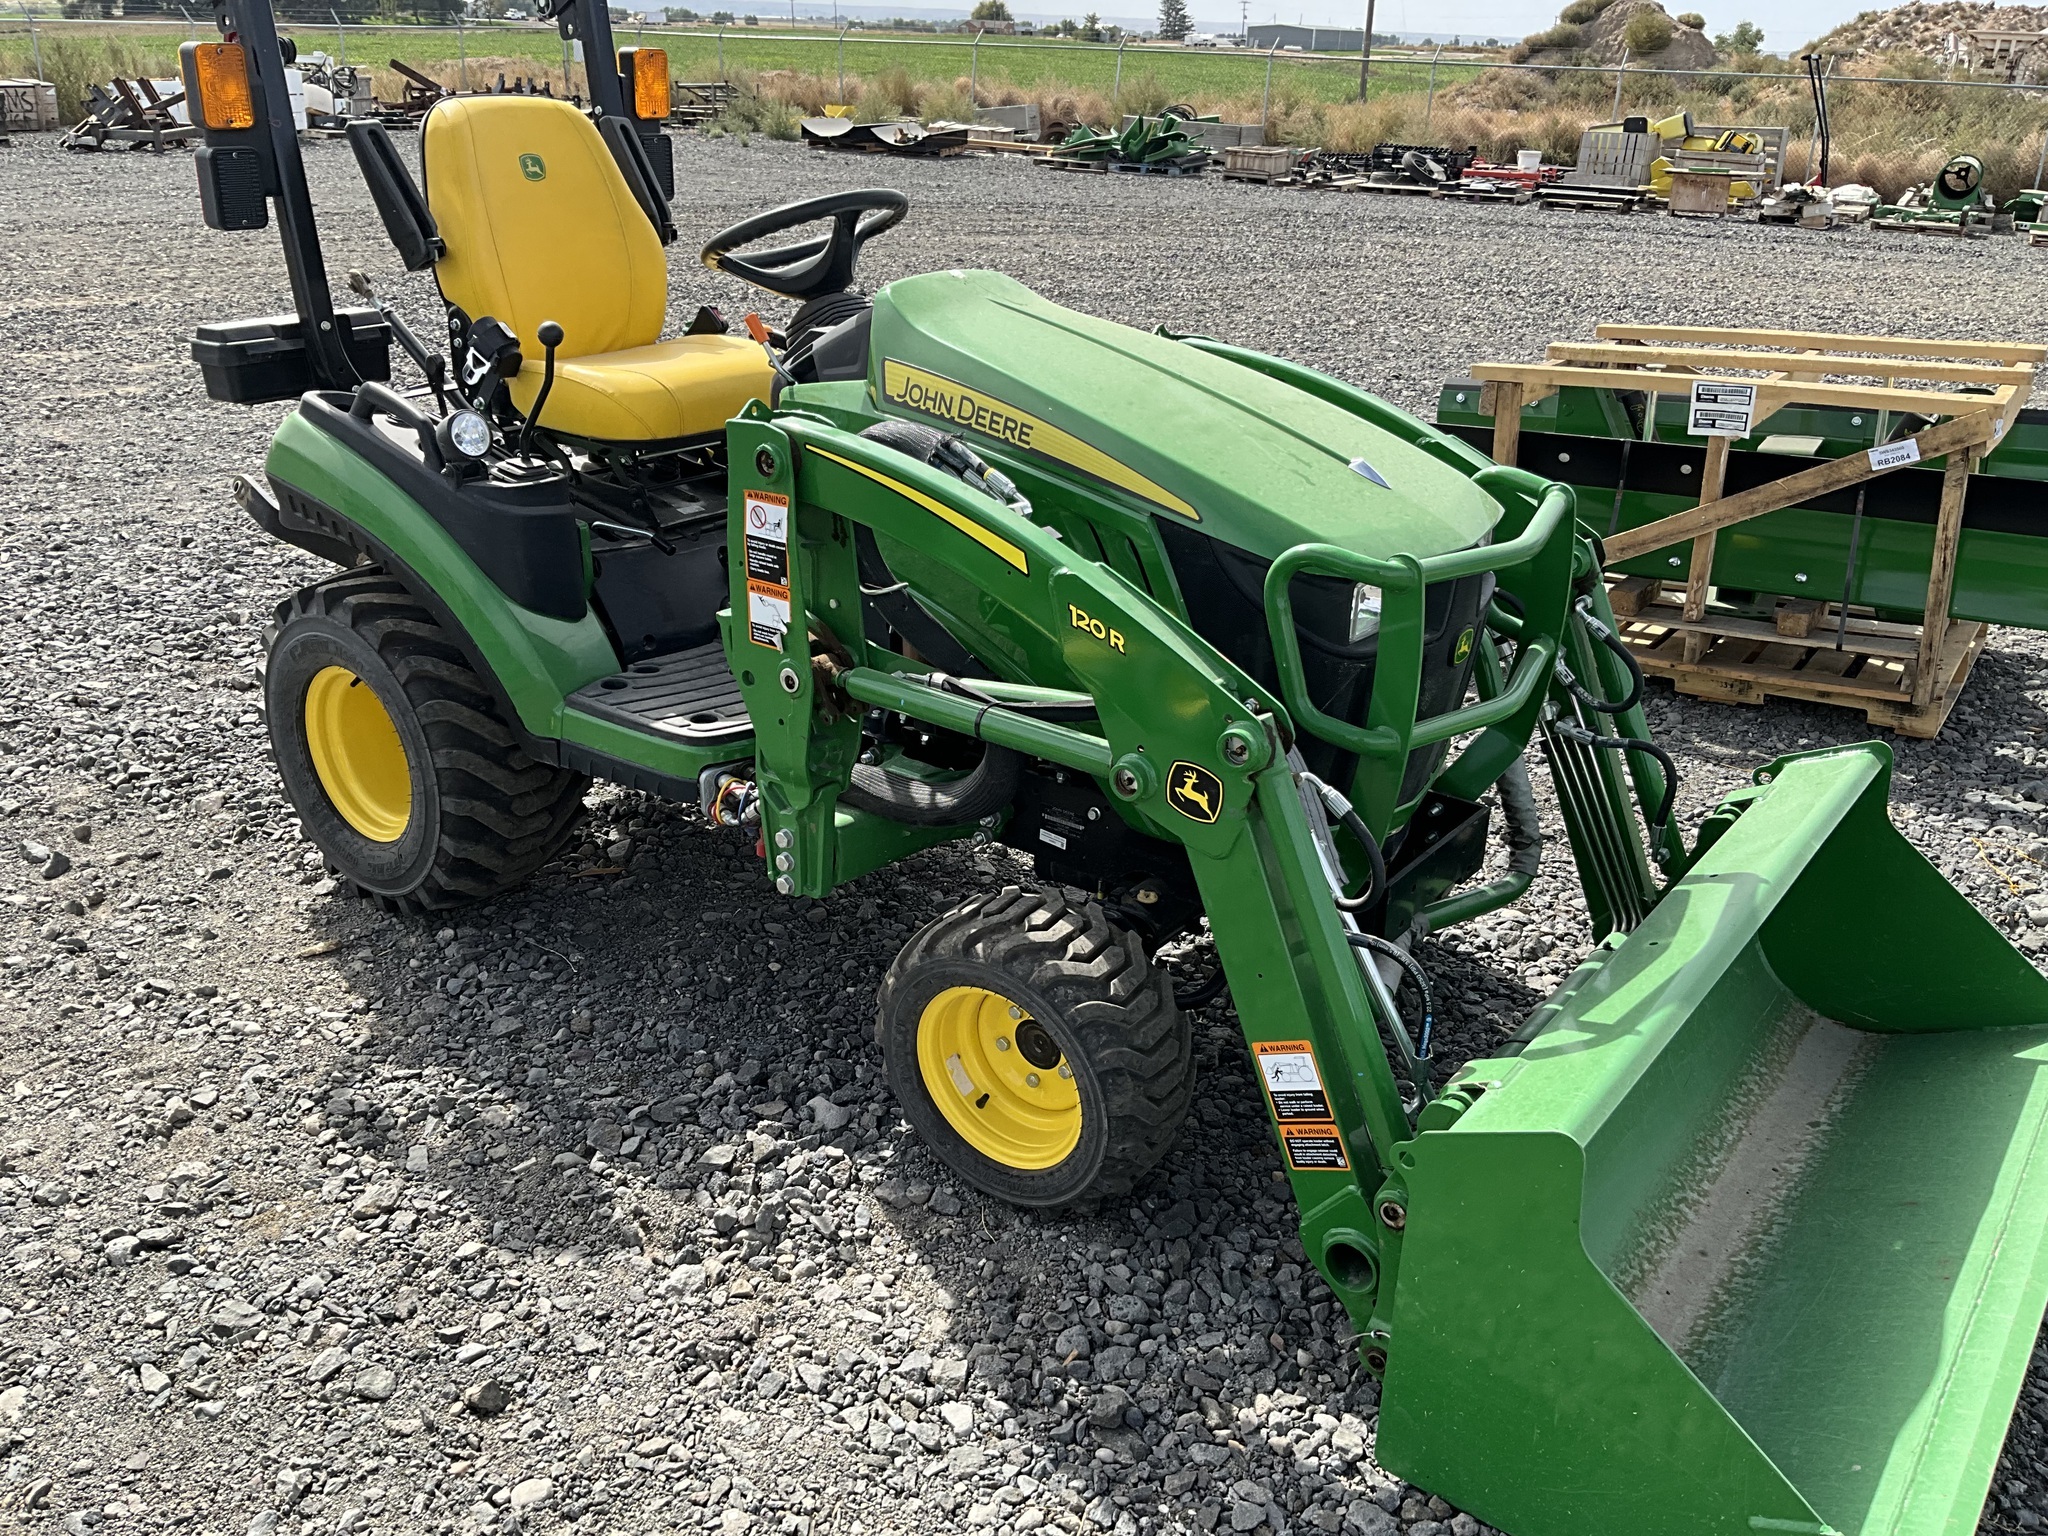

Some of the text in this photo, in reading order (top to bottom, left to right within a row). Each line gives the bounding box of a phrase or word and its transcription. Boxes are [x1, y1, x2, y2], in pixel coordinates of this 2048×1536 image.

[896, 376, 1033, 446] JOHN DEERE
[1877, 453, 1911, 466] RB2084
[753, 491, 787, 505] WARNING
[756, 585, 788, 599] WARNING
[1068, 603, 1126, 656] 120 R
[1268, 1044, 1305, 1052] WARNING
[1295, 1128, 1334, 1136] WARNING
